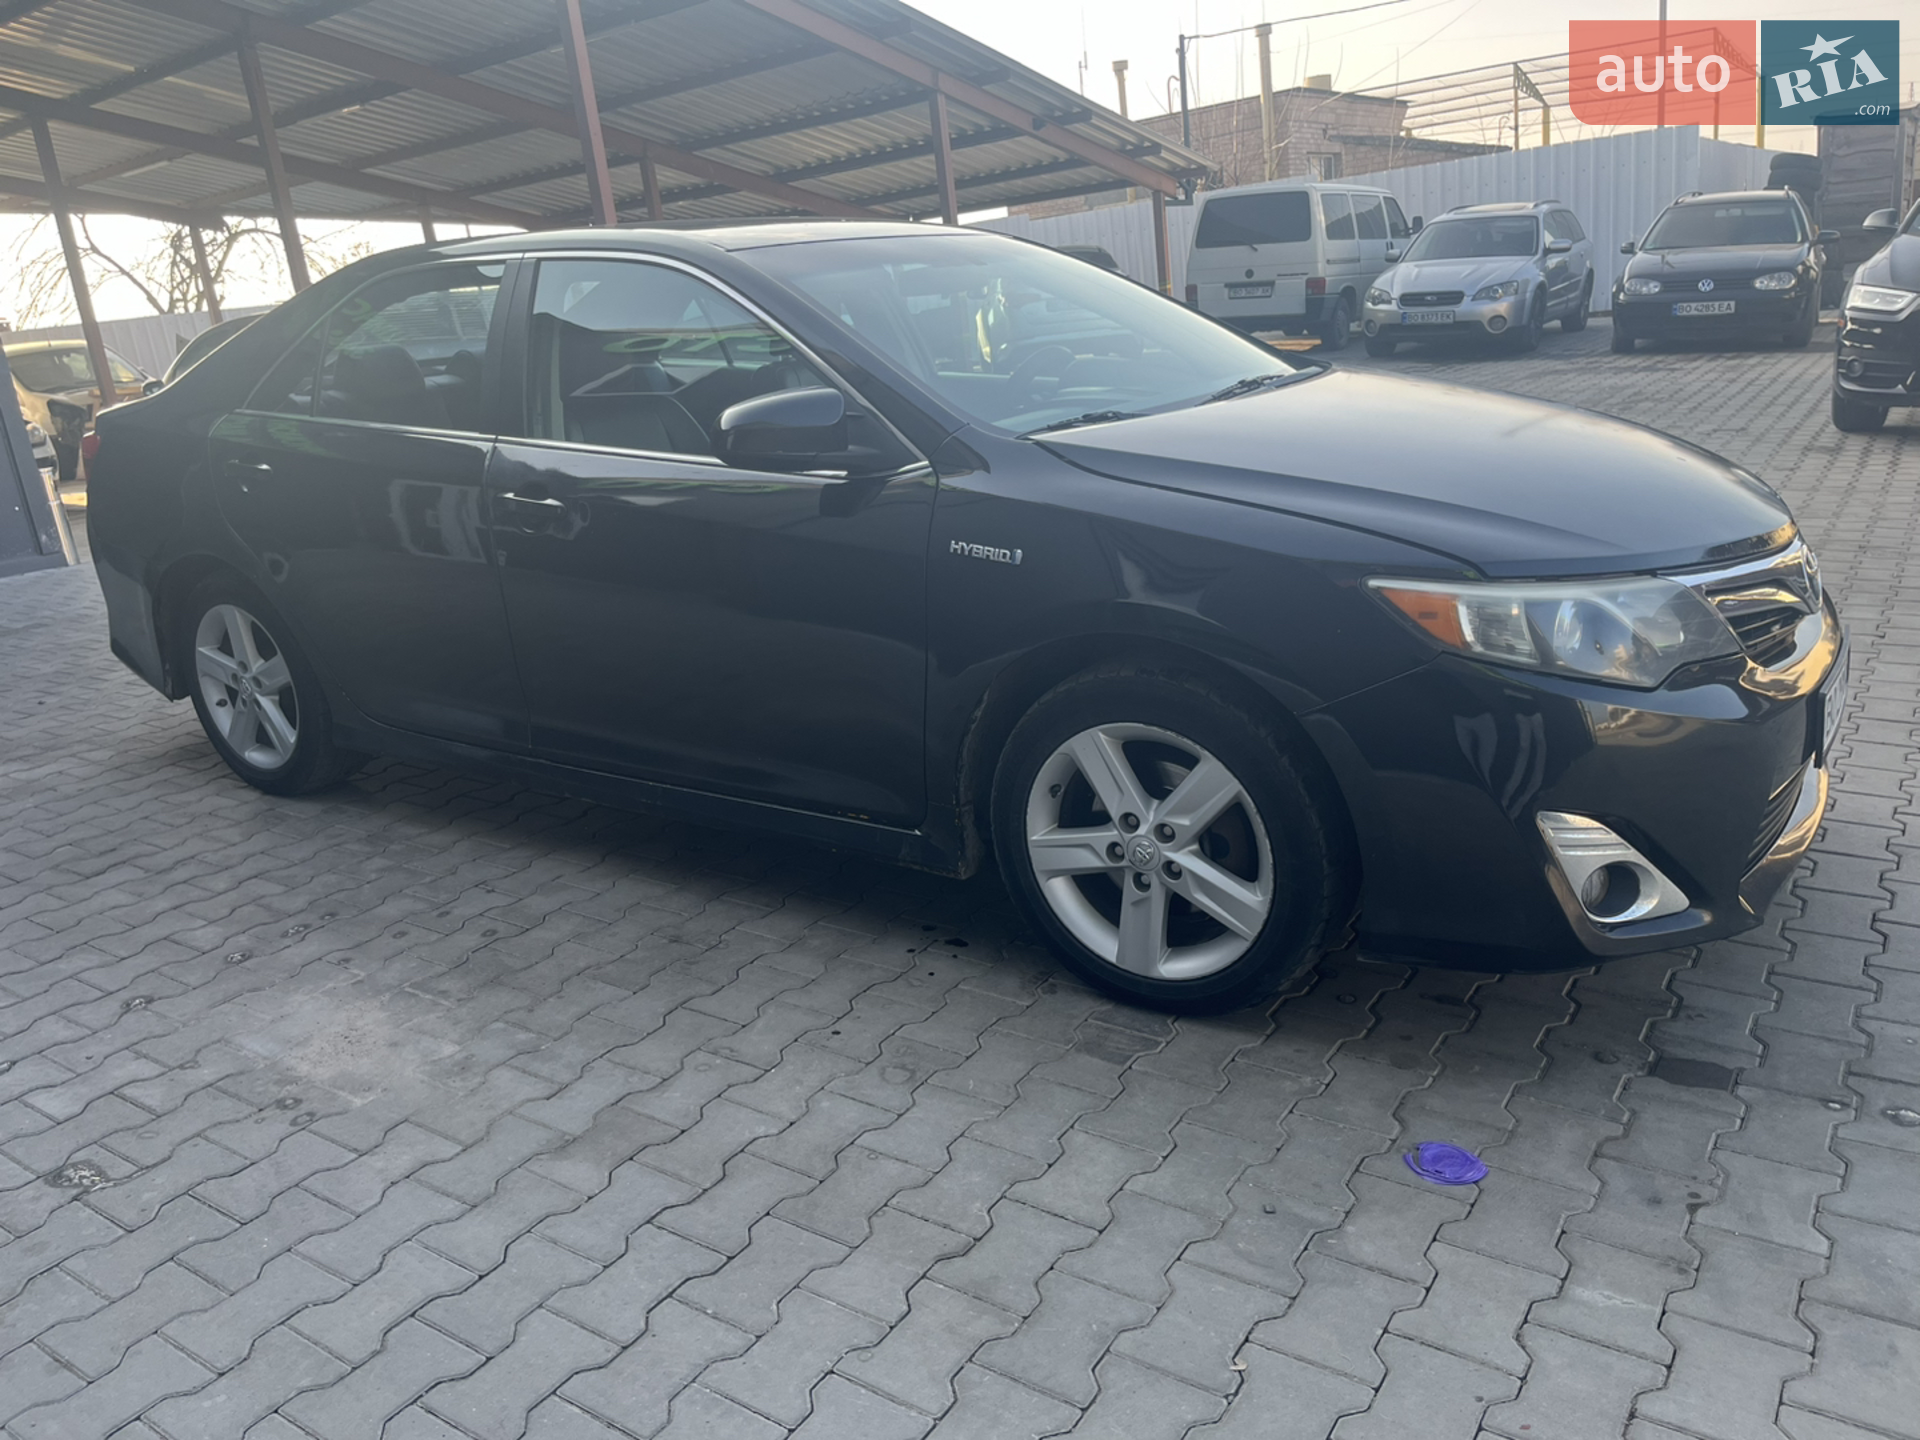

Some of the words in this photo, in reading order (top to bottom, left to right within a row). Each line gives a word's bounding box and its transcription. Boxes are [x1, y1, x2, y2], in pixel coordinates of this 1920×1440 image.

[1679, 304, 1692, 313] BO
[1694, 303, 1716, 313] 4285
[1718, 302, 1732, 312] EA
[1408, 314, 1419, 322] BO
[1440, 312, 1452, 321] EK
[949, 540, 1012, 564] HYBRID
